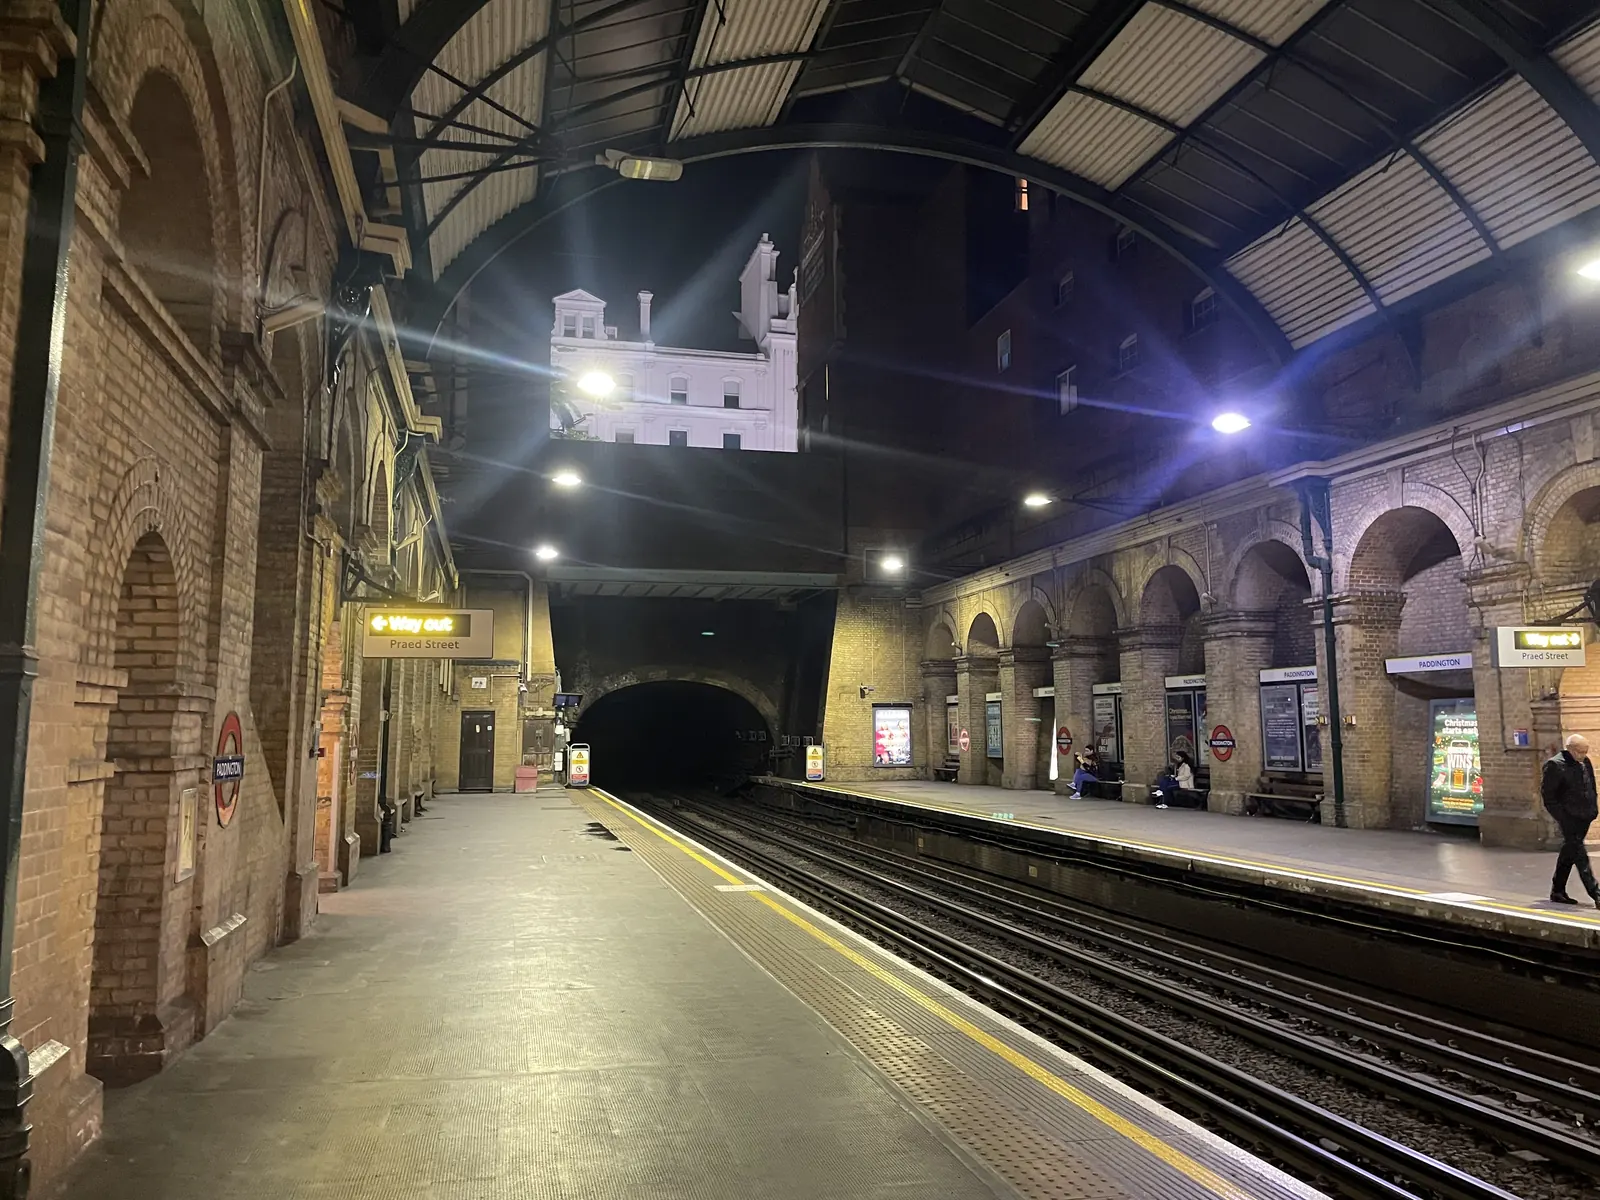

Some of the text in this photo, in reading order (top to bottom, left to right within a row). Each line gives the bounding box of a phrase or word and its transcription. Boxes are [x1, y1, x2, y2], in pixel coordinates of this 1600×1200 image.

[389, 615, 454, 633] Way out
[390, 639, 460, 650] Praed Street
[1522, 652, 1569, 660] Praed Street
[1418, 658, 1461, 669] PADDINGTON
[1284, 669, 1315, 679] PADDINGTON
[1446, 752, 1474, 769] WINS
[216, 761, 241, 777] PADDINGTON
